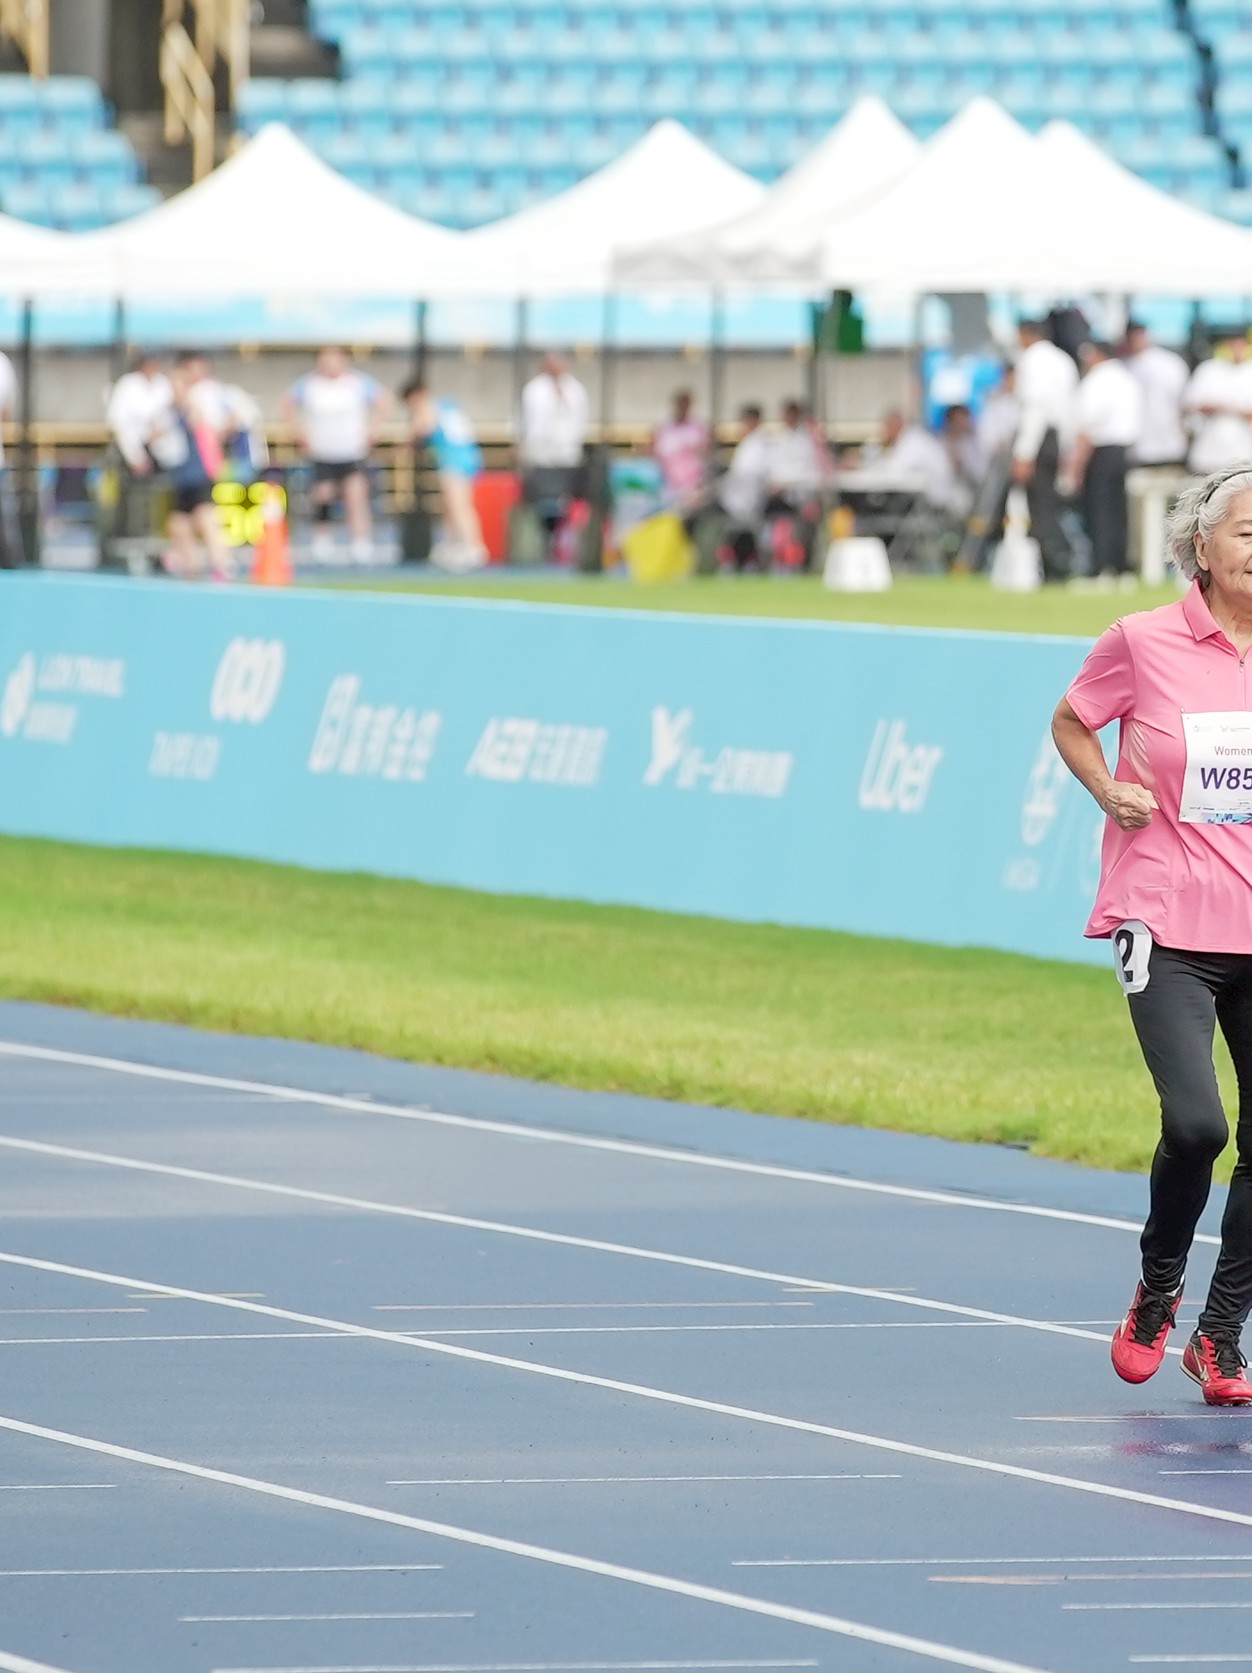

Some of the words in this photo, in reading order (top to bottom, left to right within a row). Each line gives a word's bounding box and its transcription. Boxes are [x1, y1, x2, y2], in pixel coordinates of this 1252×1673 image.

[859, 718, 943, 812] Uber
[1214, 746, 1252, 756] Women
[1115, 929, 1134, 982] 2
